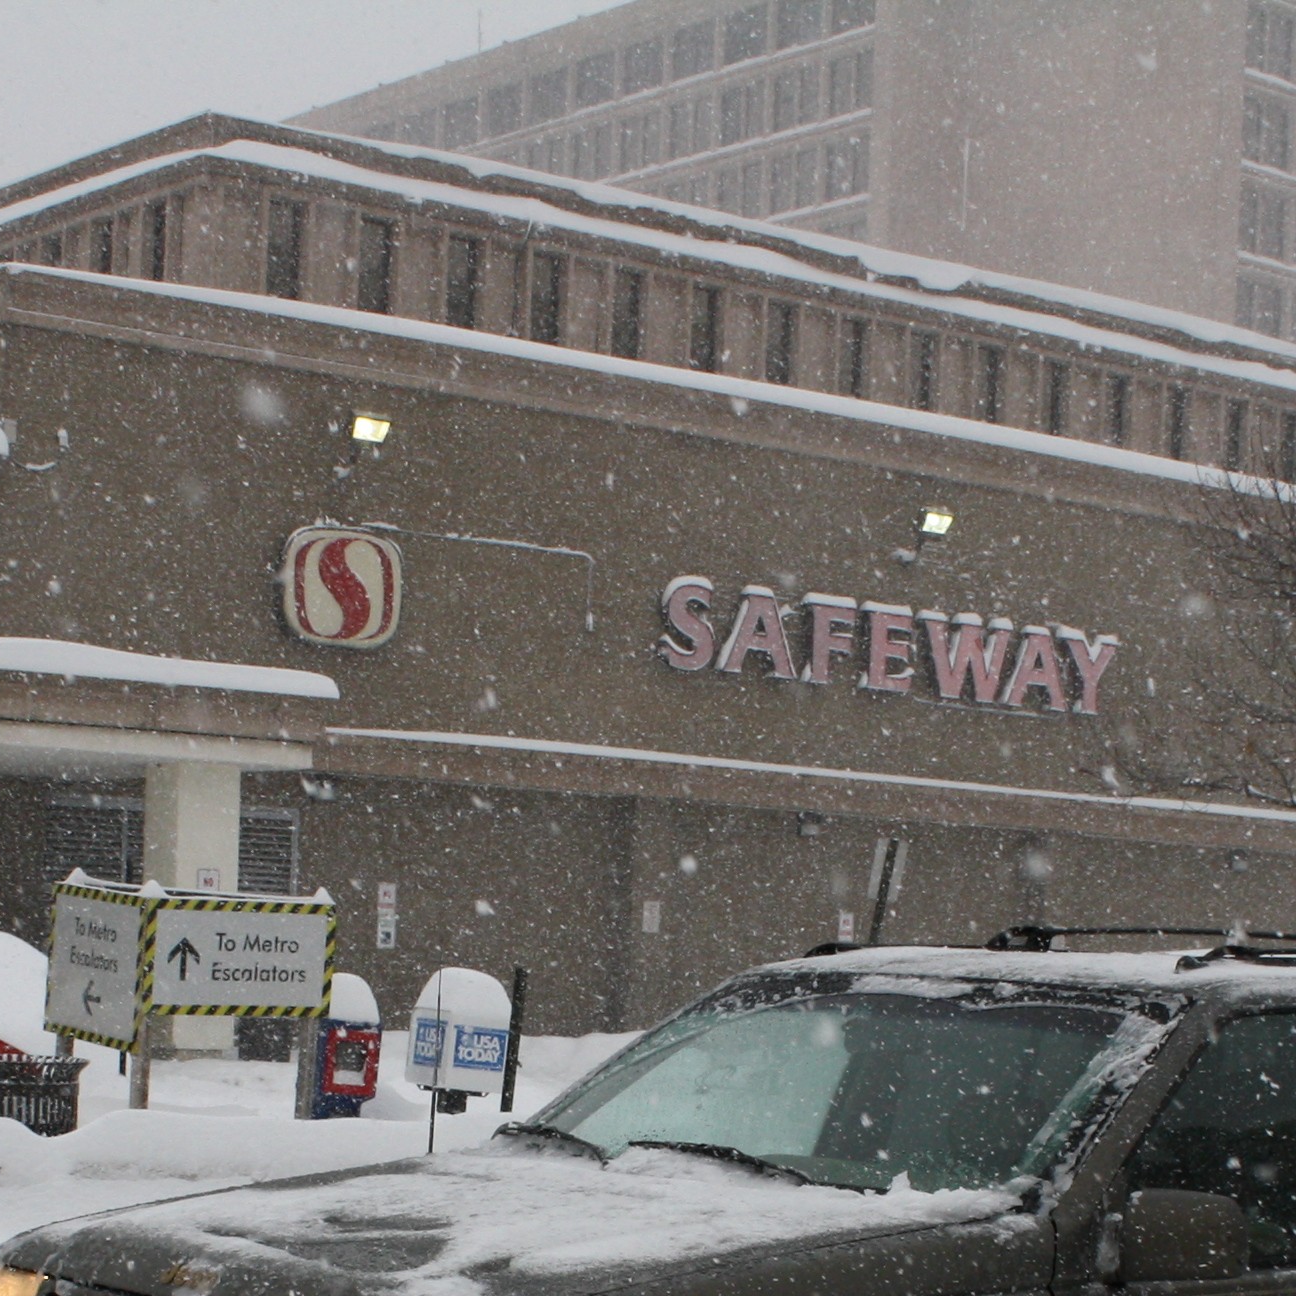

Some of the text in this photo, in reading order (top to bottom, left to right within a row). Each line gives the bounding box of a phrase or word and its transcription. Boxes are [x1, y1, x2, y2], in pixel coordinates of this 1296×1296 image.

[658, 575, 1121, 715] SAFEWAY
[75, 915, 118, 943] To Metro
[215, 932, 300, 954] To Metro
[70, 945, 119, 973] Escalators
[211, 961, 307, 983] Escalators
[473, 1034, 500, 1051] USA
[457, 1045, 502, 1063] TODAY
